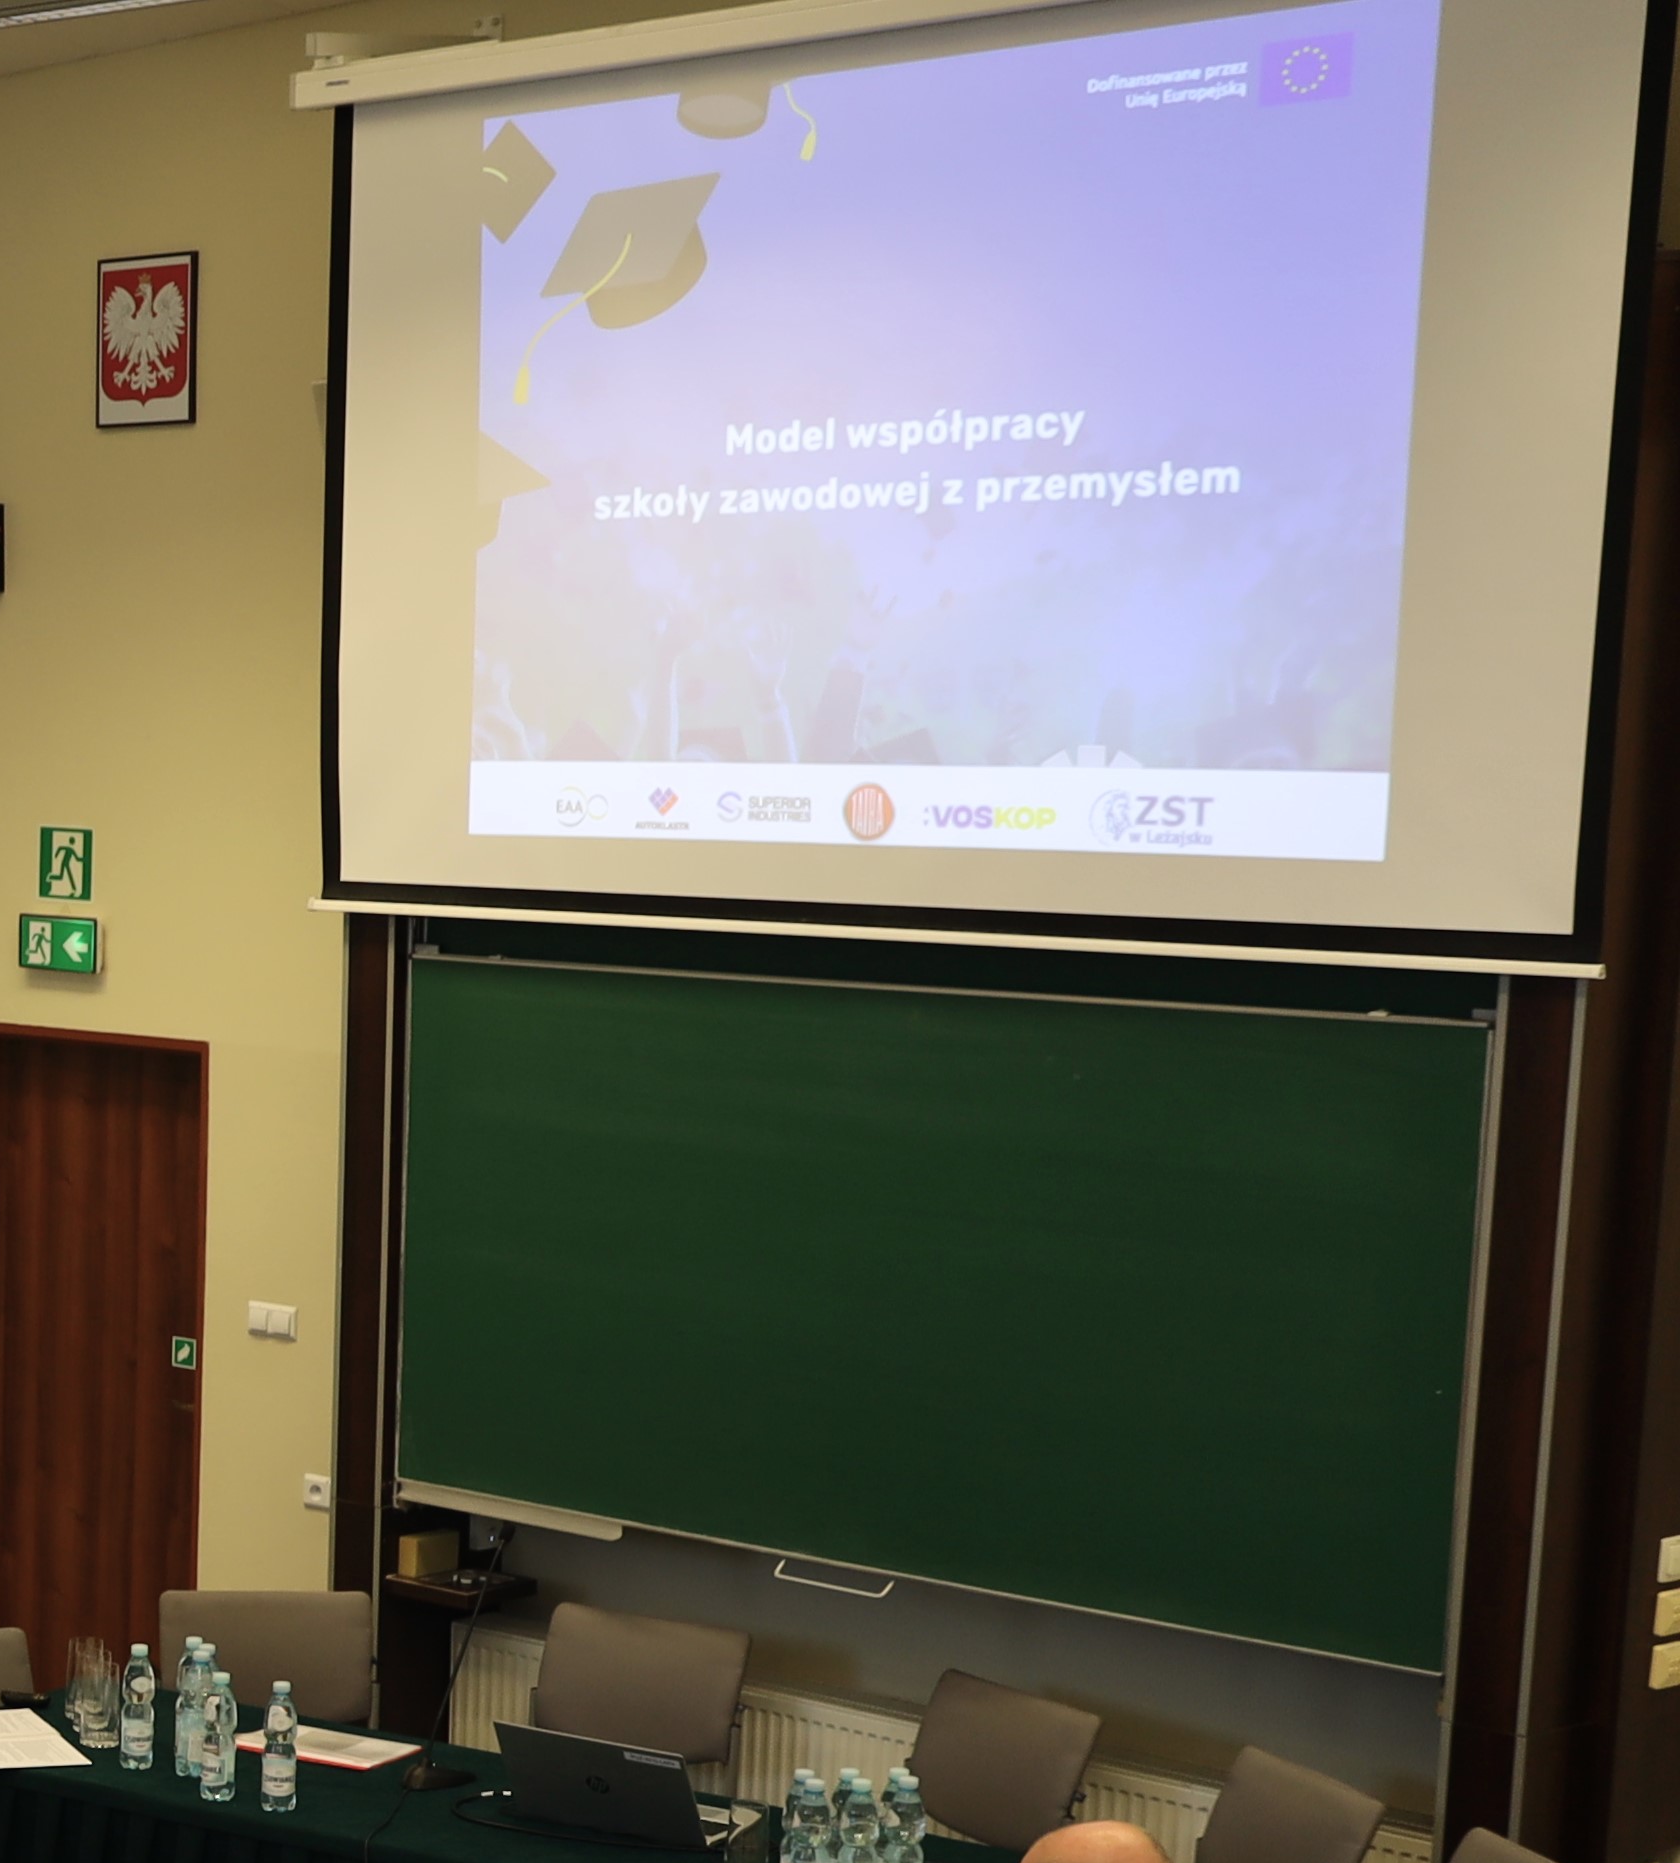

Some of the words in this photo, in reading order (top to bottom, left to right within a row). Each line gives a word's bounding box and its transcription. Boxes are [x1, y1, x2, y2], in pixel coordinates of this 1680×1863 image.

[1204, 61, 1249, 82] przez
[725, 417, 836, 456] Model
[846, 409, 1086, 454] współpracy
[594, 484, 710, 523] szkoły
[718, 471, 931, 515] zawodowej
[942, 478, 965, 505] z
[976, 459, 1243, 512] przemysłem
[556, 799, 584, 814] EAA
[748, 796, 812, 809] SUPERIOR
[1134, 795, 1214, 827] ZST
[748, 810, 812, 822] INDUSTRIES
[1128, 832, 1142, 844] w
